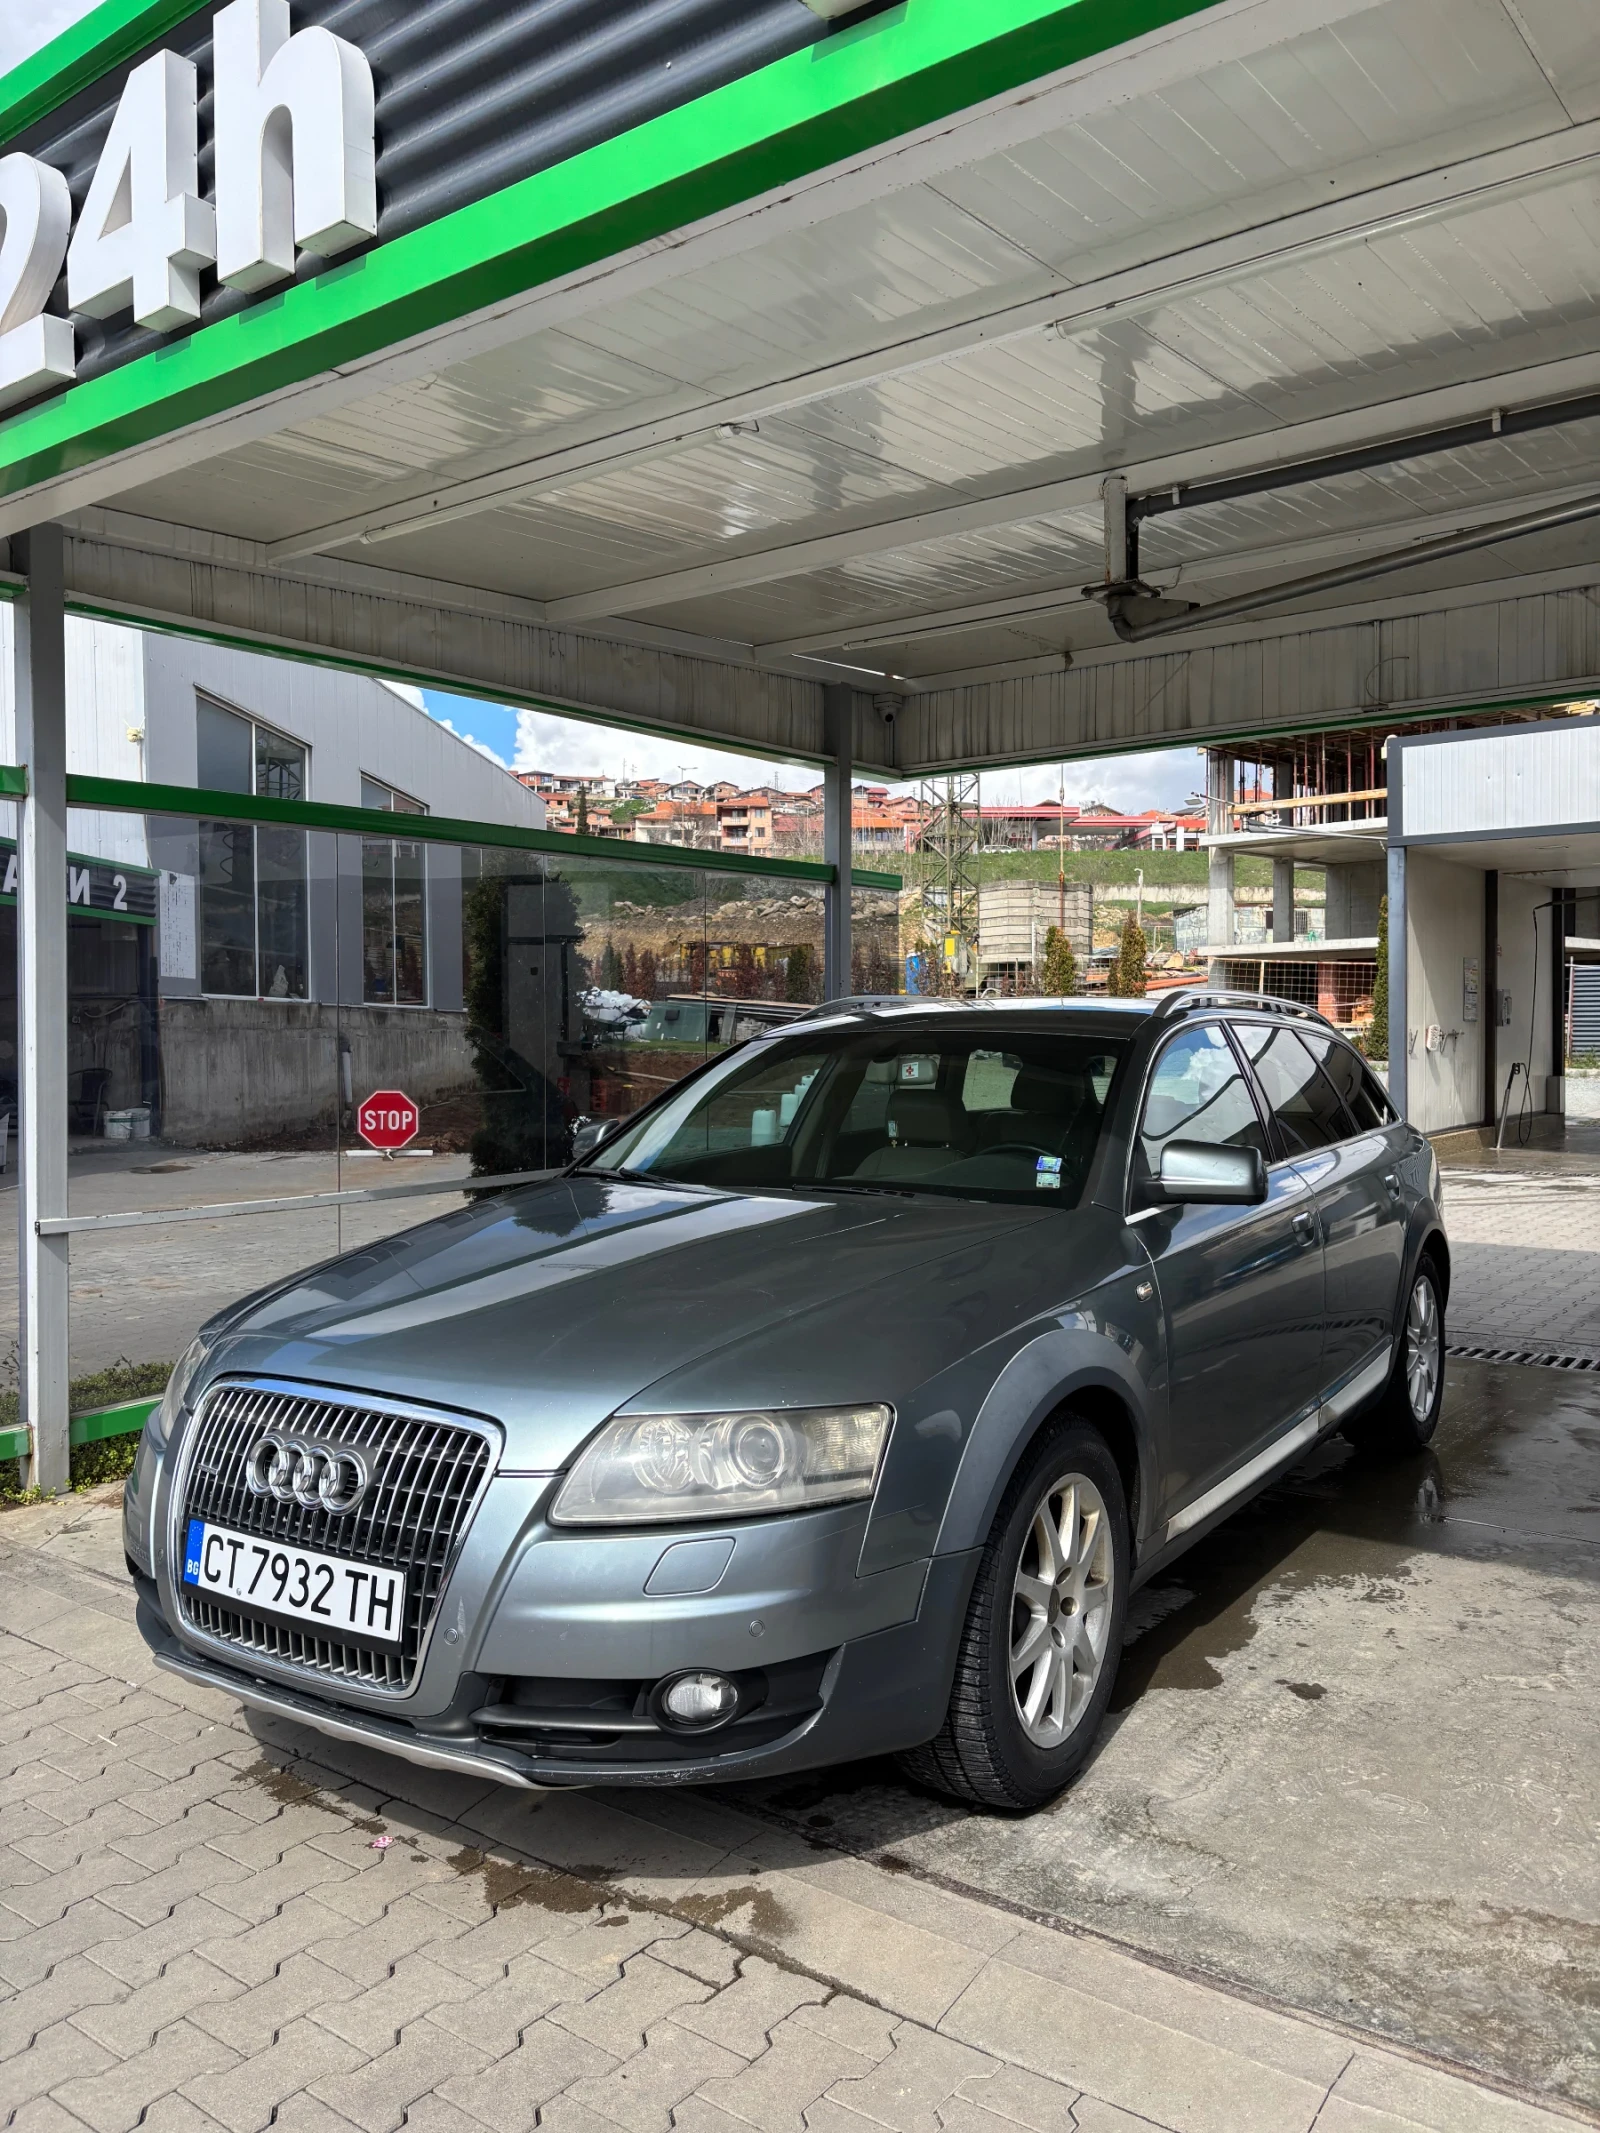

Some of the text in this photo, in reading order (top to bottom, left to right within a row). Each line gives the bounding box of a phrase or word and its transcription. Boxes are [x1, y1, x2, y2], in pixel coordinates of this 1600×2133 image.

[113, 874, 128, 911] 2
[364, 1110, 413, 1131] STOP
[186, 1558, 200, 1576] BG
[203, 1533, 396, 1631] CT 7932 TH
